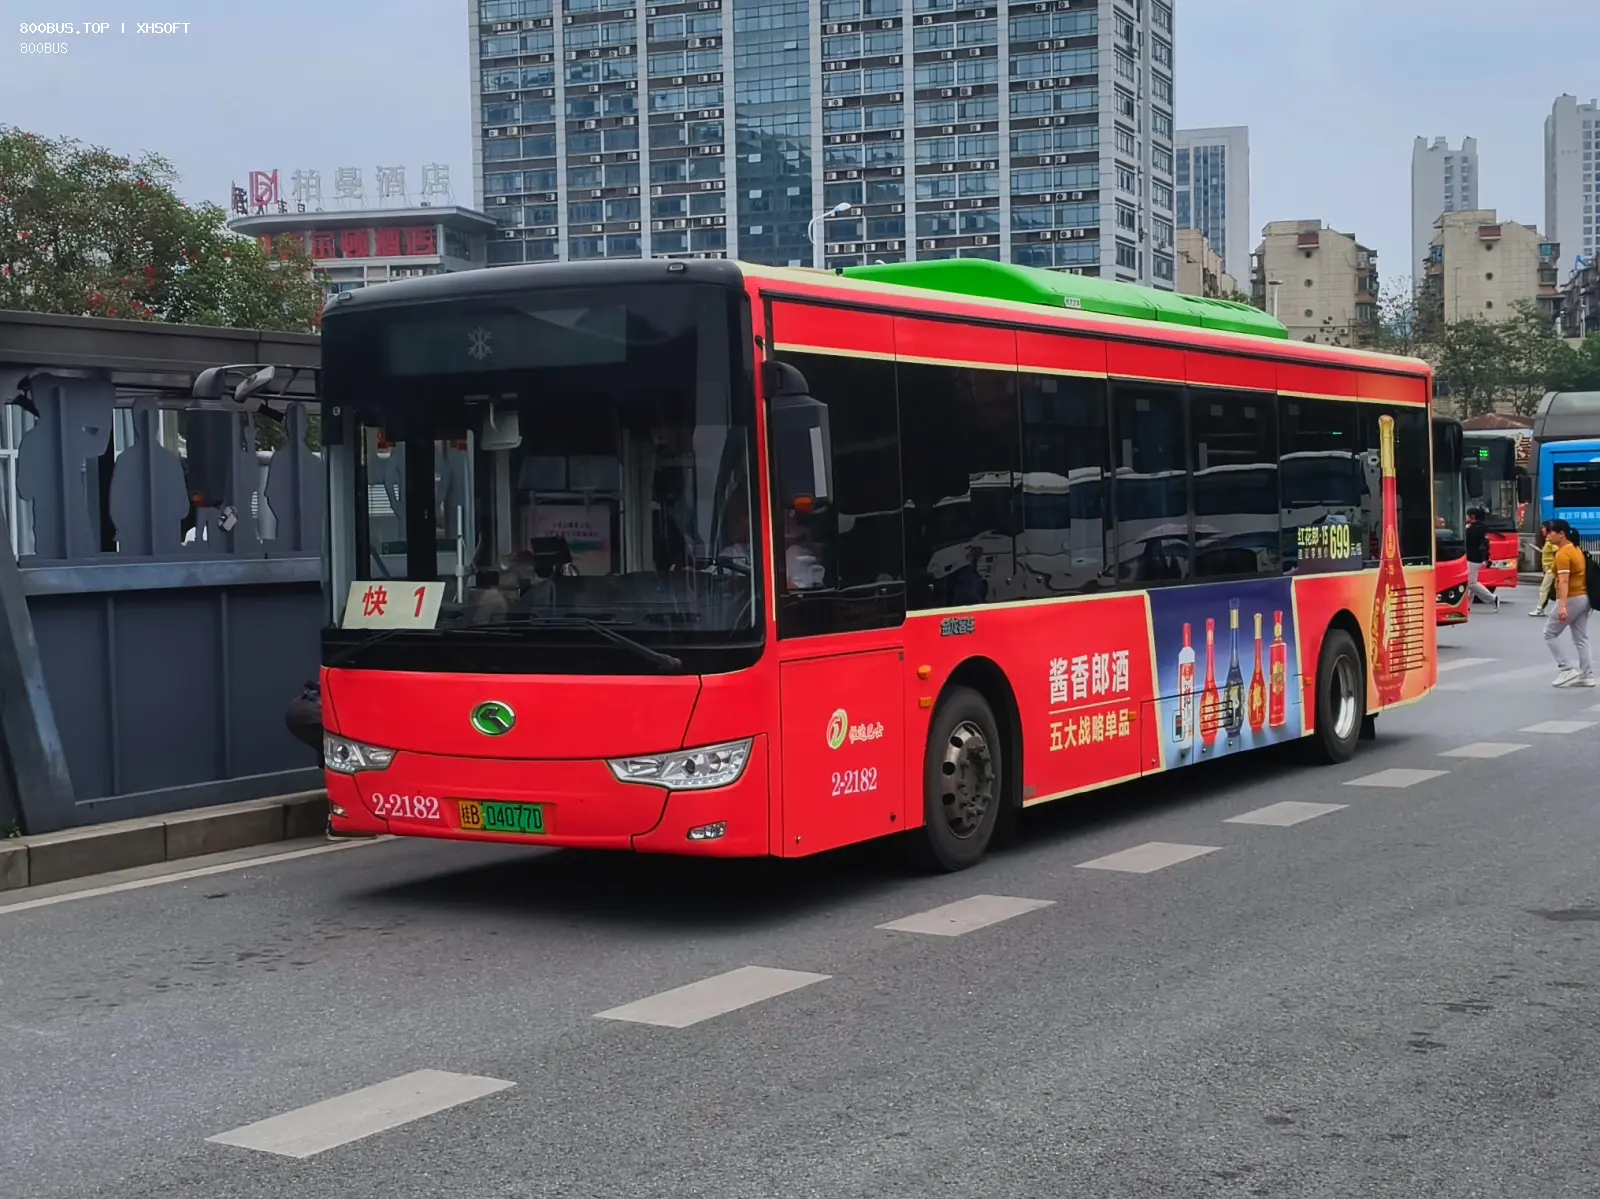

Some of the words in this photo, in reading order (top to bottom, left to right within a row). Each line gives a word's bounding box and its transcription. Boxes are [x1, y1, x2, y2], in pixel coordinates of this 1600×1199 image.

[291, 162, 450, 200] 柏曼酒店
[1330, 524, 1350, 559] 699
[362, 585, 387, 617] 快
[414, 586, 426, 618] 1
[1049, 650, 1129, 704] 酱香郎酒
[1049, 708, 1130, 751] 五大战略单品
[831, 767, 877, 796] 2-2182
[372, 792, 440, 819] 2-2182
